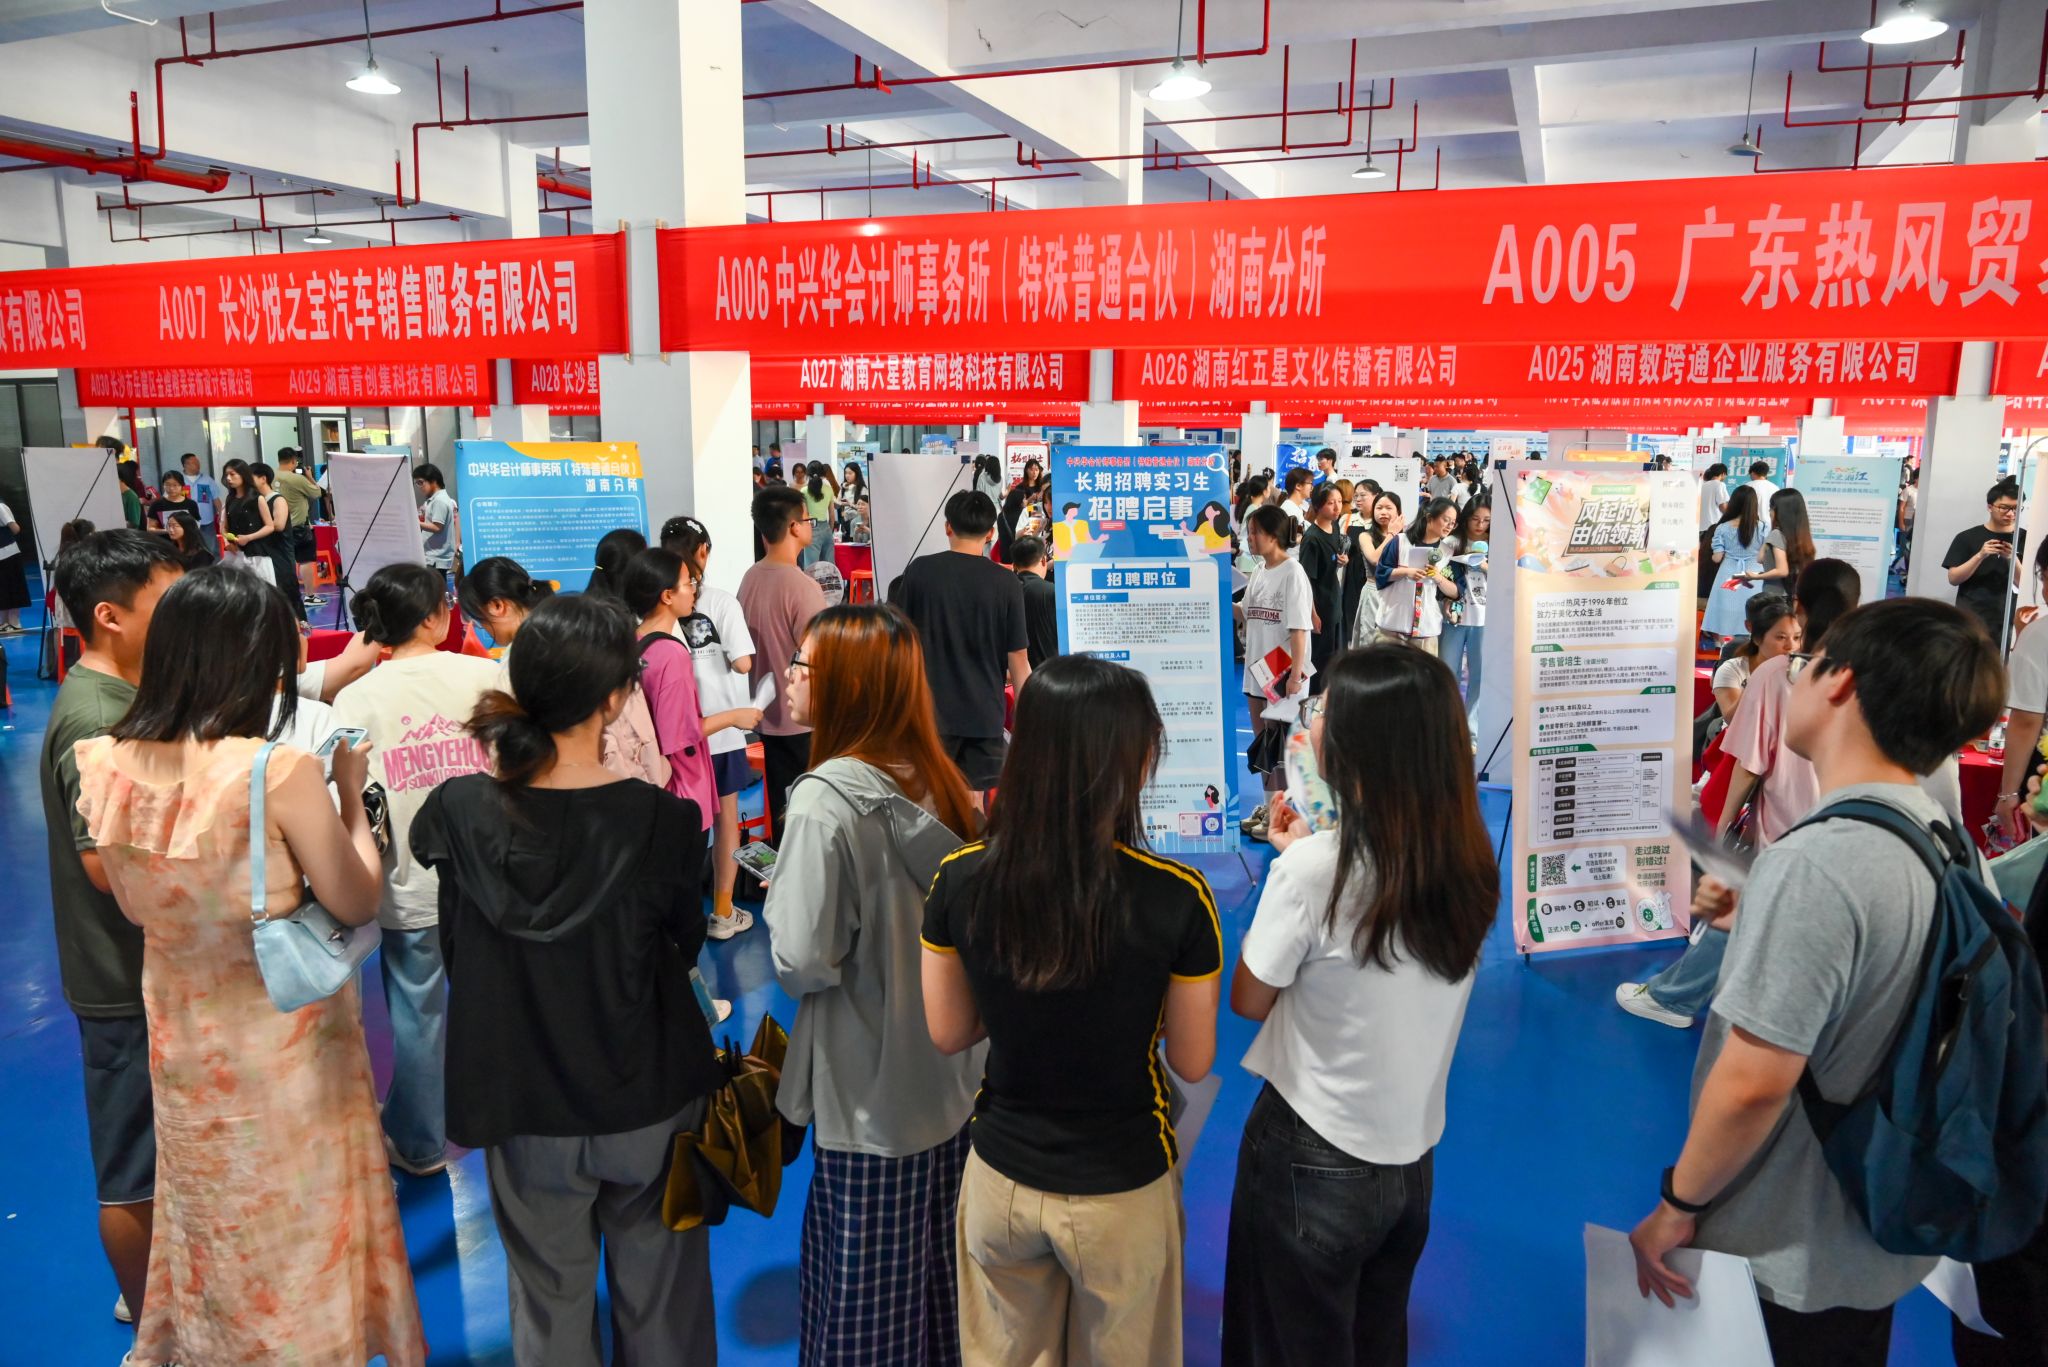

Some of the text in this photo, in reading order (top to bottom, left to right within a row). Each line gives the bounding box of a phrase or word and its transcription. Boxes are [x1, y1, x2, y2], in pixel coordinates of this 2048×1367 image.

[1483, 195, 2048, 313] A005 广东热风贸
[716, 225, 1327, 328] A006 中兴华会计师事务所（特殊普通合伙）湖南分所
[159, 259, 578, 345] A007 长沙悦之宝汽车销售服务有限公司
[289, 363, 479, 396] A029 湖南青创集科技有限公司
[531, 365, 560, 392] A028
[800, 353, 1064, 391] A027 湖南六星教育网络科技有限公司
[1141, 345, 1457, 388] A026 湖南红五星文化传播有限公司
[1528, 341, 1920, 385] A025 湖南数跨通企业服务有限公司
[91, 374, 110, 397] A030
[1074, 471, 1210, 493] 长期招聘实习生
[1088, 496, 1193, 521] 招聘启事
[1106, 571, 1177, 587] 招聘职位
[1634, 845, 1670, 855] 走过路过
